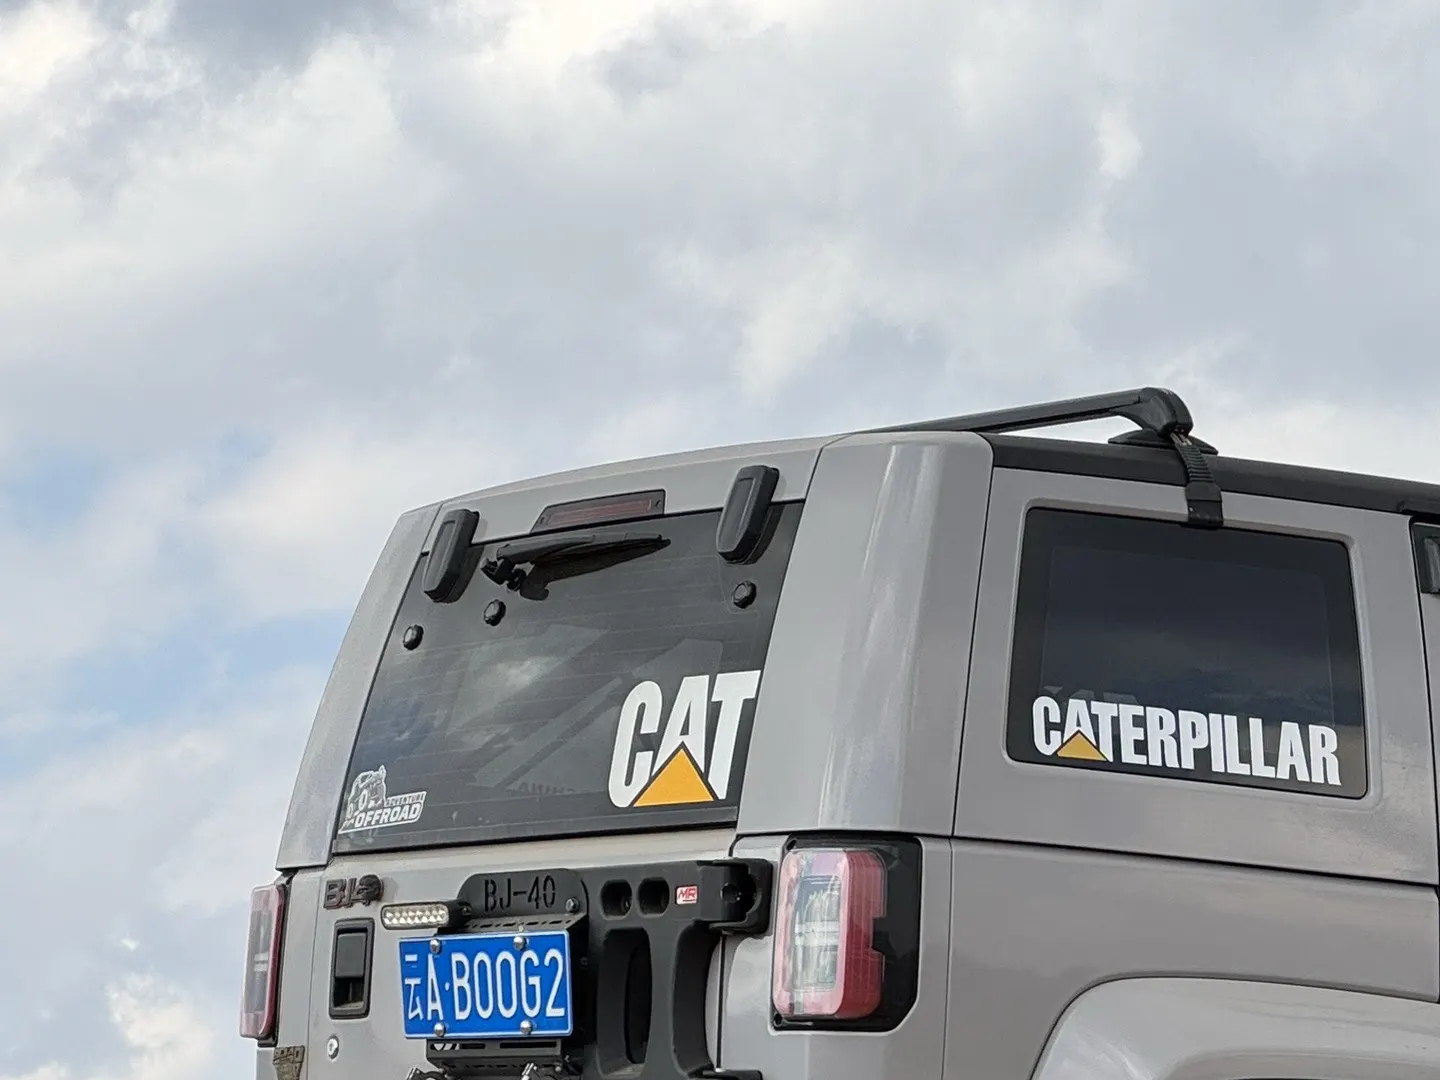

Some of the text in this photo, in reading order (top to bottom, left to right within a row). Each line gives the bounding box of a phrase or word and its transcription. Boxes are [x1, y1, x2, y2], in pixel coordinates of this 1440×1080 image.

[608, 670, 761, 808] CAT
[1032, 696, 1342, 786] CATERPILLAR
[354, 803, 421, 828] OFFROAD
[484, 875, 556, 912] BJ-40
